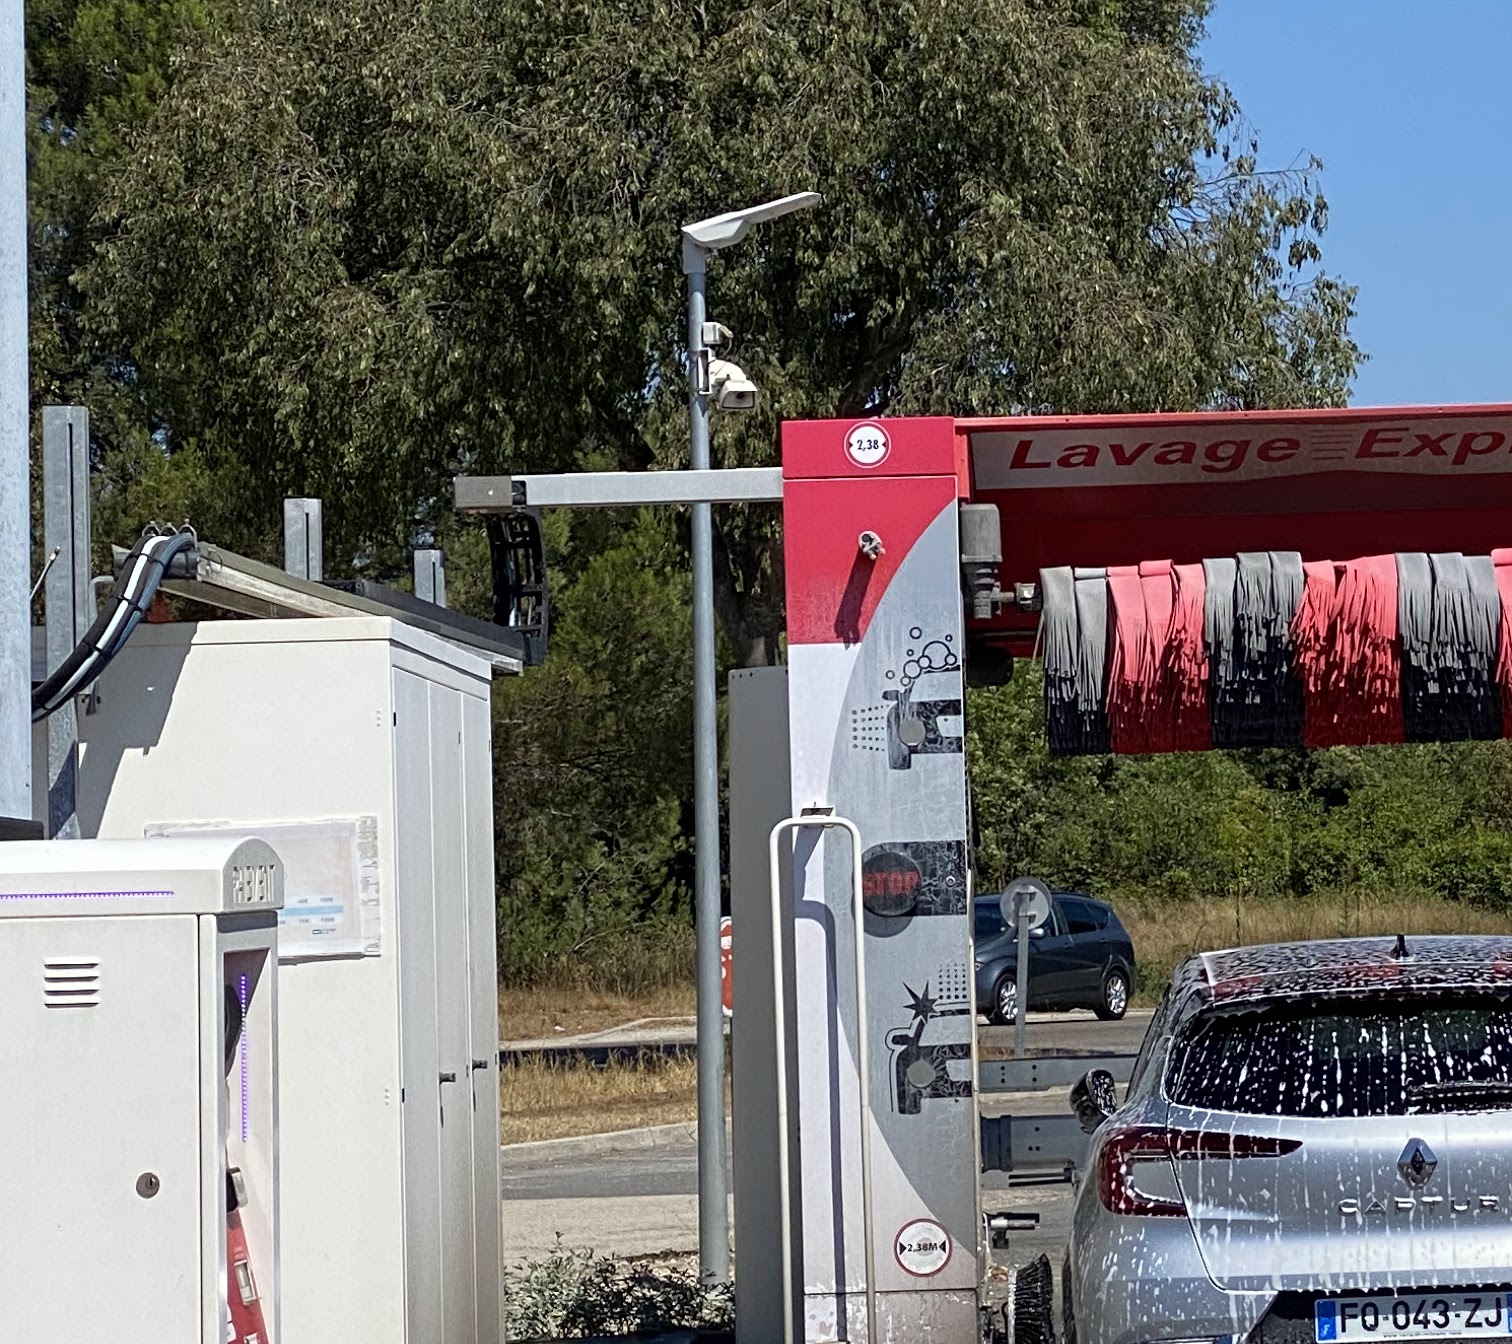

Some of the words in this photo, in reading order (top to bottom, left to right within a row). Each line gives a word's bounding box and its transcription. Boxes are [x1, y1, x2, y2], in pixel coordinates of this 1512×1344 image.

[856, 439, 879, 451] 2,38
[1009, 437, 1300, 474] Lavage
[1338, 1195, 1499, 1215] CAPTUR
